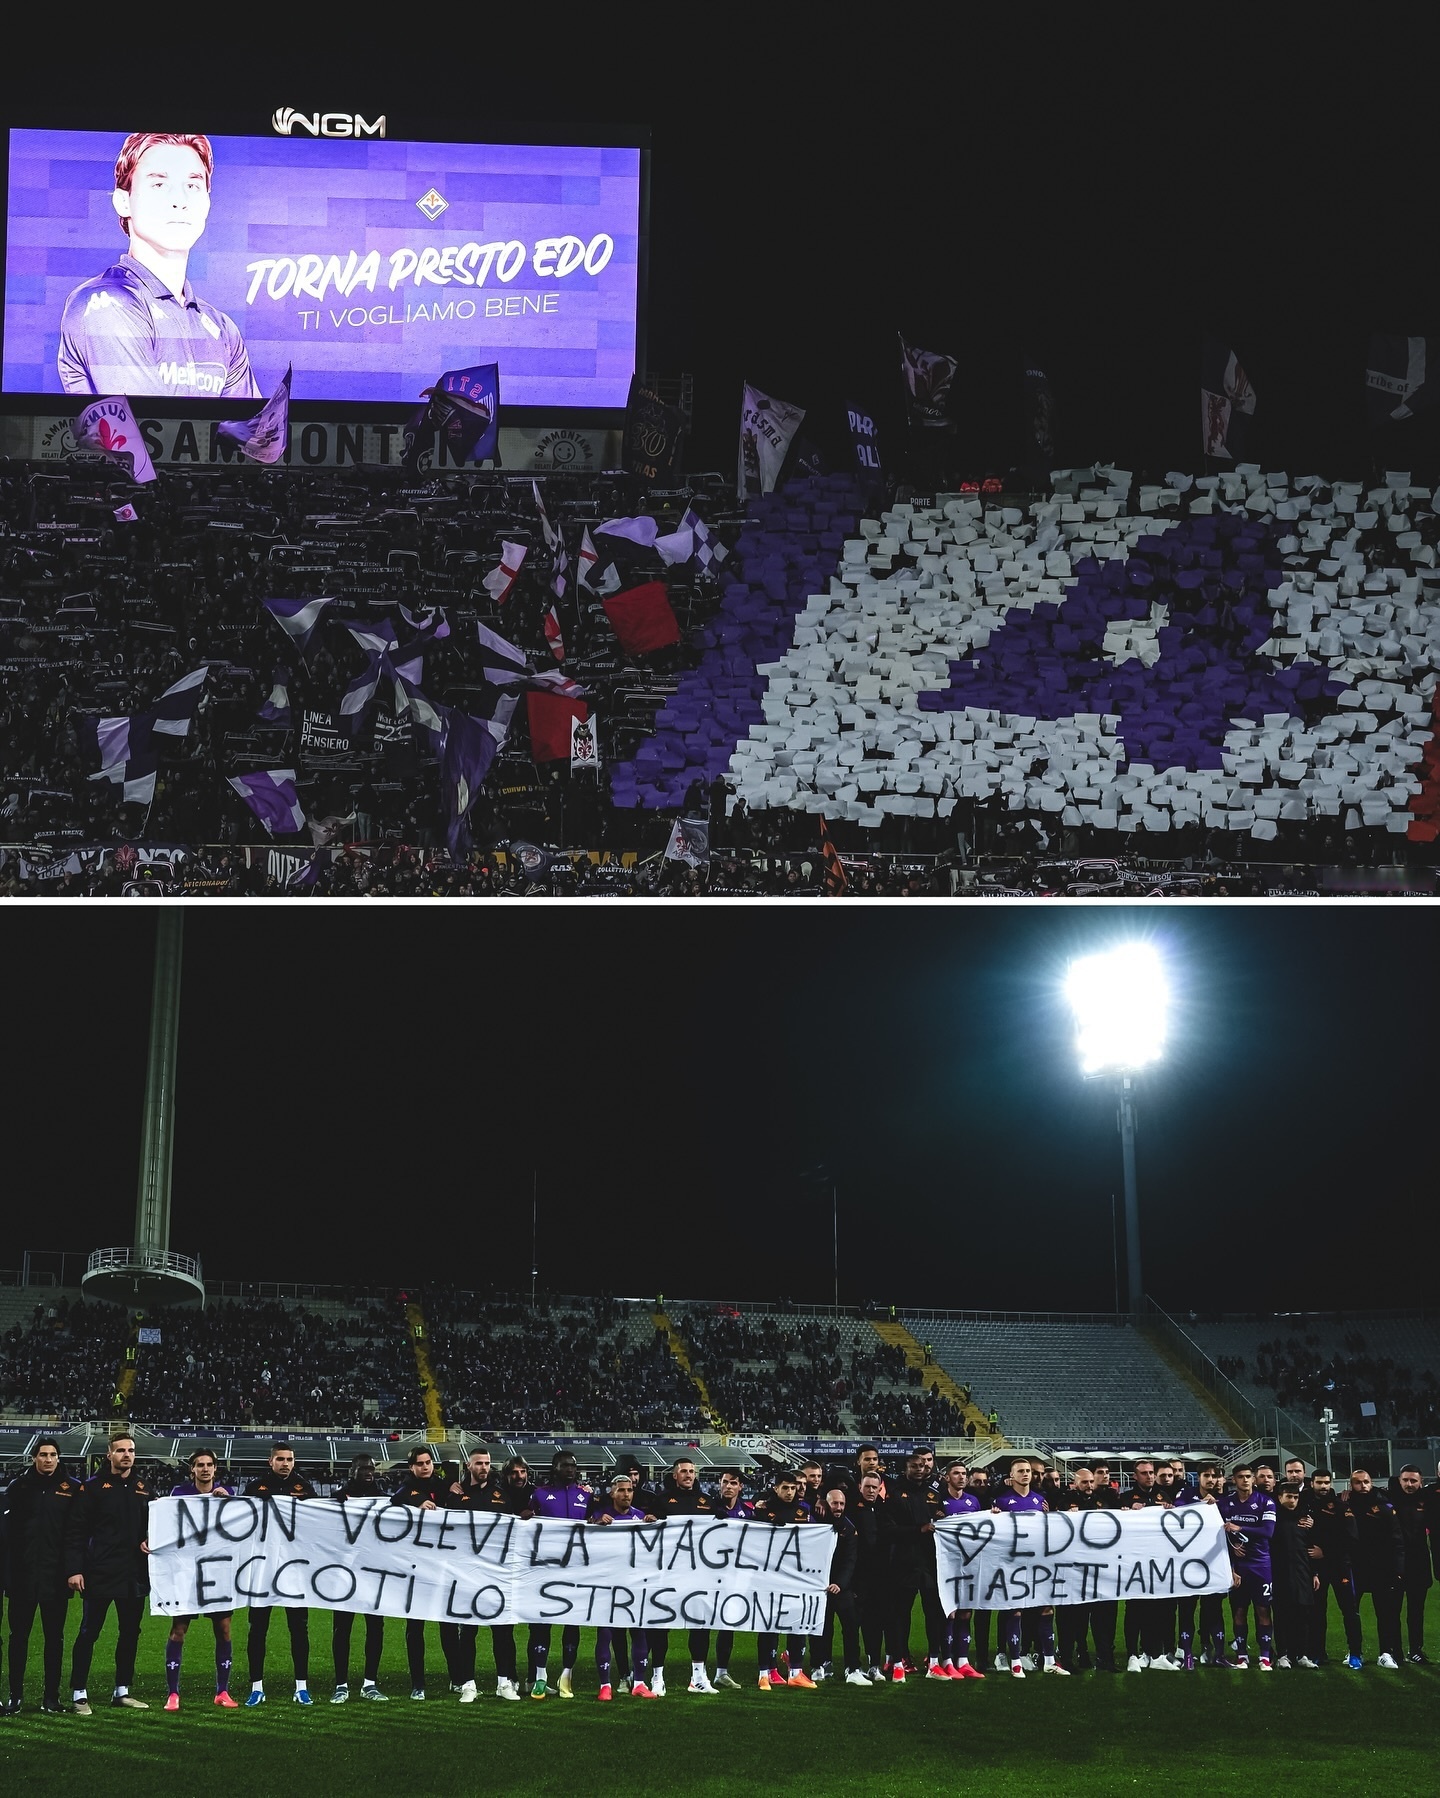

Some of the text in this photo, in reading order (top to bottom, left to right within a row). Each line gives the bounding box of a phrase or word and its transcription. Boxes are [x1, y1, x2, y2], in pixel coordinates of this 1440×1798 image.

[287, 112, 386, 138] NGM
[246, 233, 614, 305] TORNA PRESTO EDO
[298, 295, 560, 330] TI VOGLIAMO BENE
[534, 429, 594, 460] SAMMONTANA
[910, 497, 931, 506] PARTE
[302, 722, 312, 734] DI
[303, 709, 332, 726] LINEA
[300, 734, 349, 751] PENSIERO
[177, 1497, 297, 1548] NON
[342, 1499, 513, 1564] VOLEVI
[530, 1523, 590, 1567] LA
[1010, 1511, 1122, 1557] EDO
[447, 1579, 506, 1619] LO
